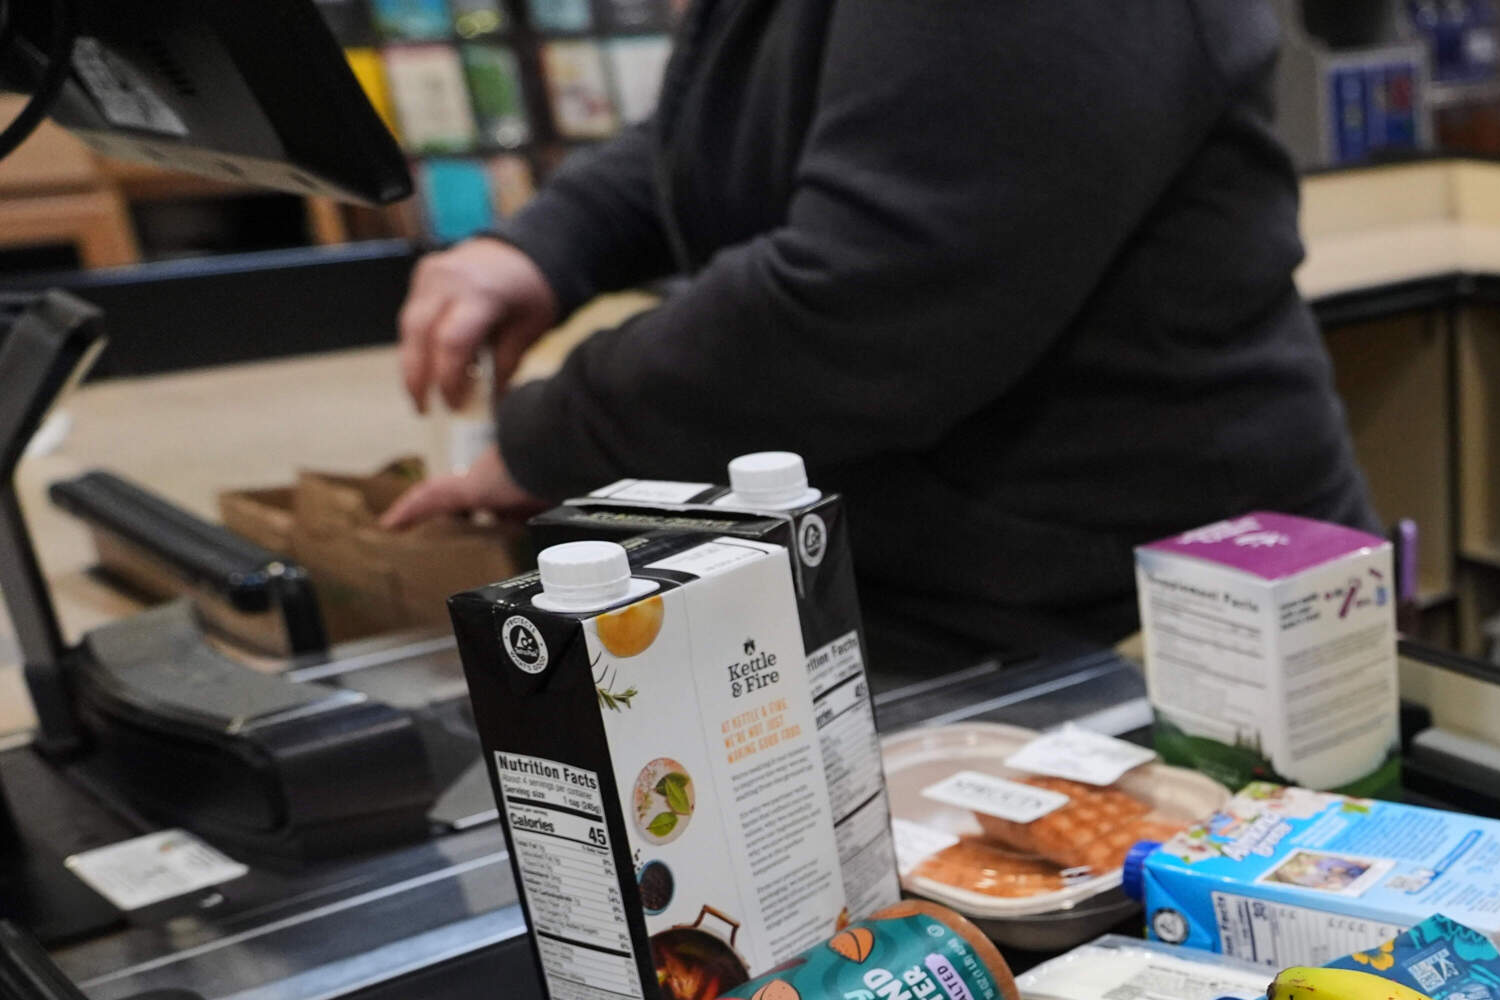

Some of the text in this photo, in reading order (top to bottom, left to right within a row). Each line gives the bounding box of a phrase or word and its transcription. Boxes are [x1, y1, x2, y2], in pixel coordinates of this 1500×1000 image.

[728, 652, 777, 682] Kettle
[731, 670, 779, 698] & Fire
[748, 722, 763, 739] NOT
[758, 733, 779, 750] GOOD
[499, 755, 598, 789] Nutrition Facts
[504, 784, 530, 799] Serving
[532, 788, 545, 799] size
[510, 812, 607, 845] Calories 45
